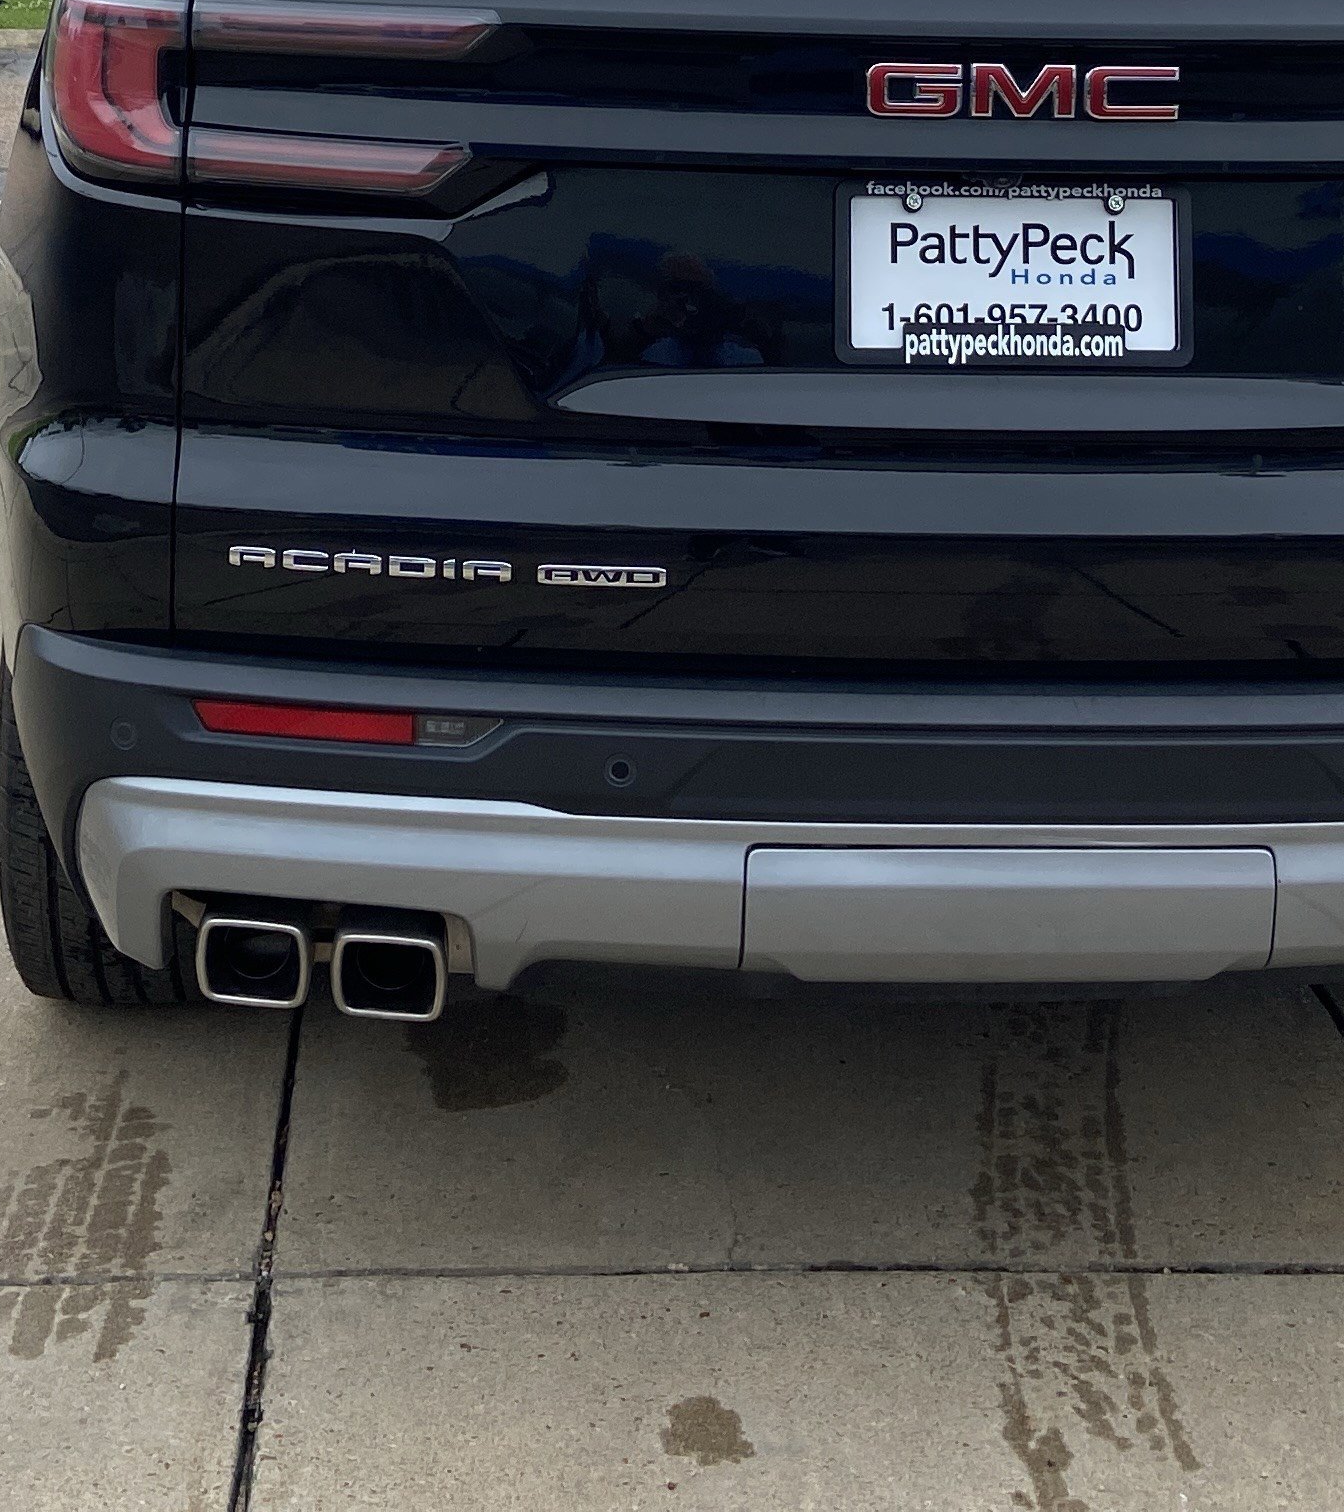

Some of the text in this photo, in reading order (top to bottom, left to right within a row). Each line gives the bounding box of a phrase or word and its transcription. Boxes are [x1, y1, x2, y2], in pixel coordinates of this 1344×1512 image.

[866, 62, 1180, 120] GMC
[866, 181, 1162, 200] facebook.com/pattypeckhonda
[890, 220, 1135, 279] PattyPeck
[1011, 268, 1117, 286] Honda
[881, 302, 1143, 332] 1-601-957-3400
[905, 324, 1124, 364] pattypeckhonda.com
[228, 545, 667, 588] ACADIA AWD
